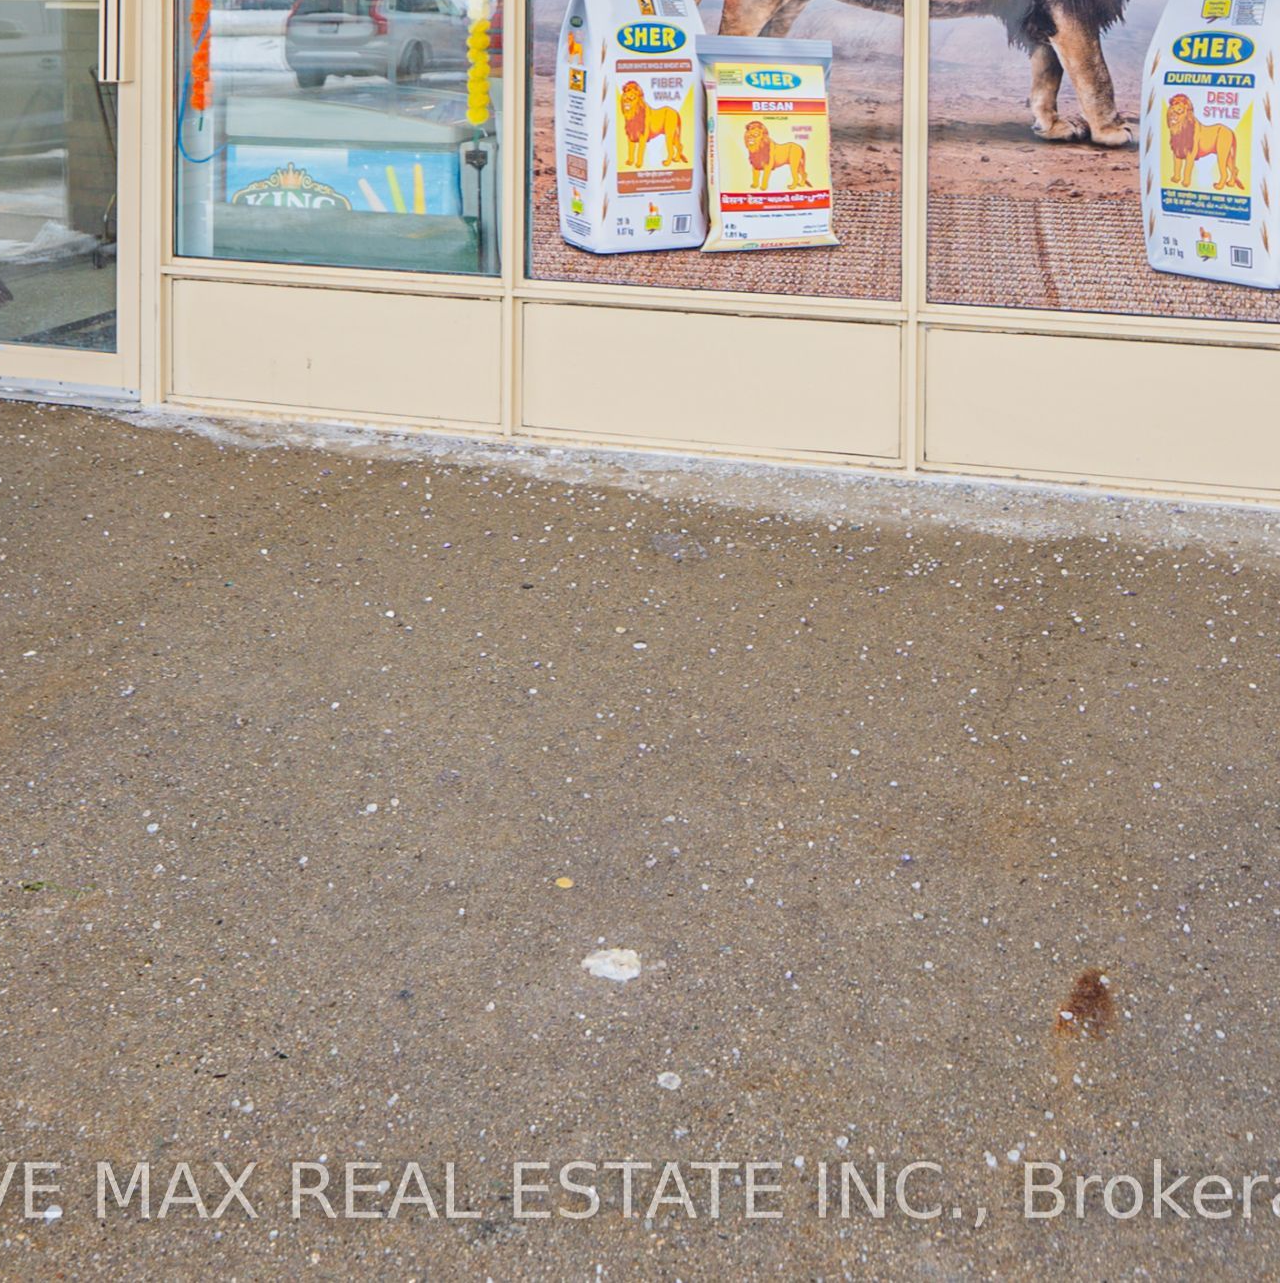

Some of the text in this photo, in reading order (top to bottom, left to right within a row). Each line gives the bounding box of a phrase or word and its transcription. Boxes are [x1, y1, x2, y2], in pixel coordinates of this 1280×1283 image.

[623, 26, 677, 49] SHER
[1178, 37, 1243, 61] SHER
[650, 77, 684, 89] FIBER
[750, 72, 795, 88] SHER
[1166, 72, 1252, 86] DURUM ATTA
[653, 91, 681, 101] WALA
[1206, 90, 1239, 105] DESI
[751, 101, 794, 111] BESAN
[1202, 105, 1241, 119] STYLE
